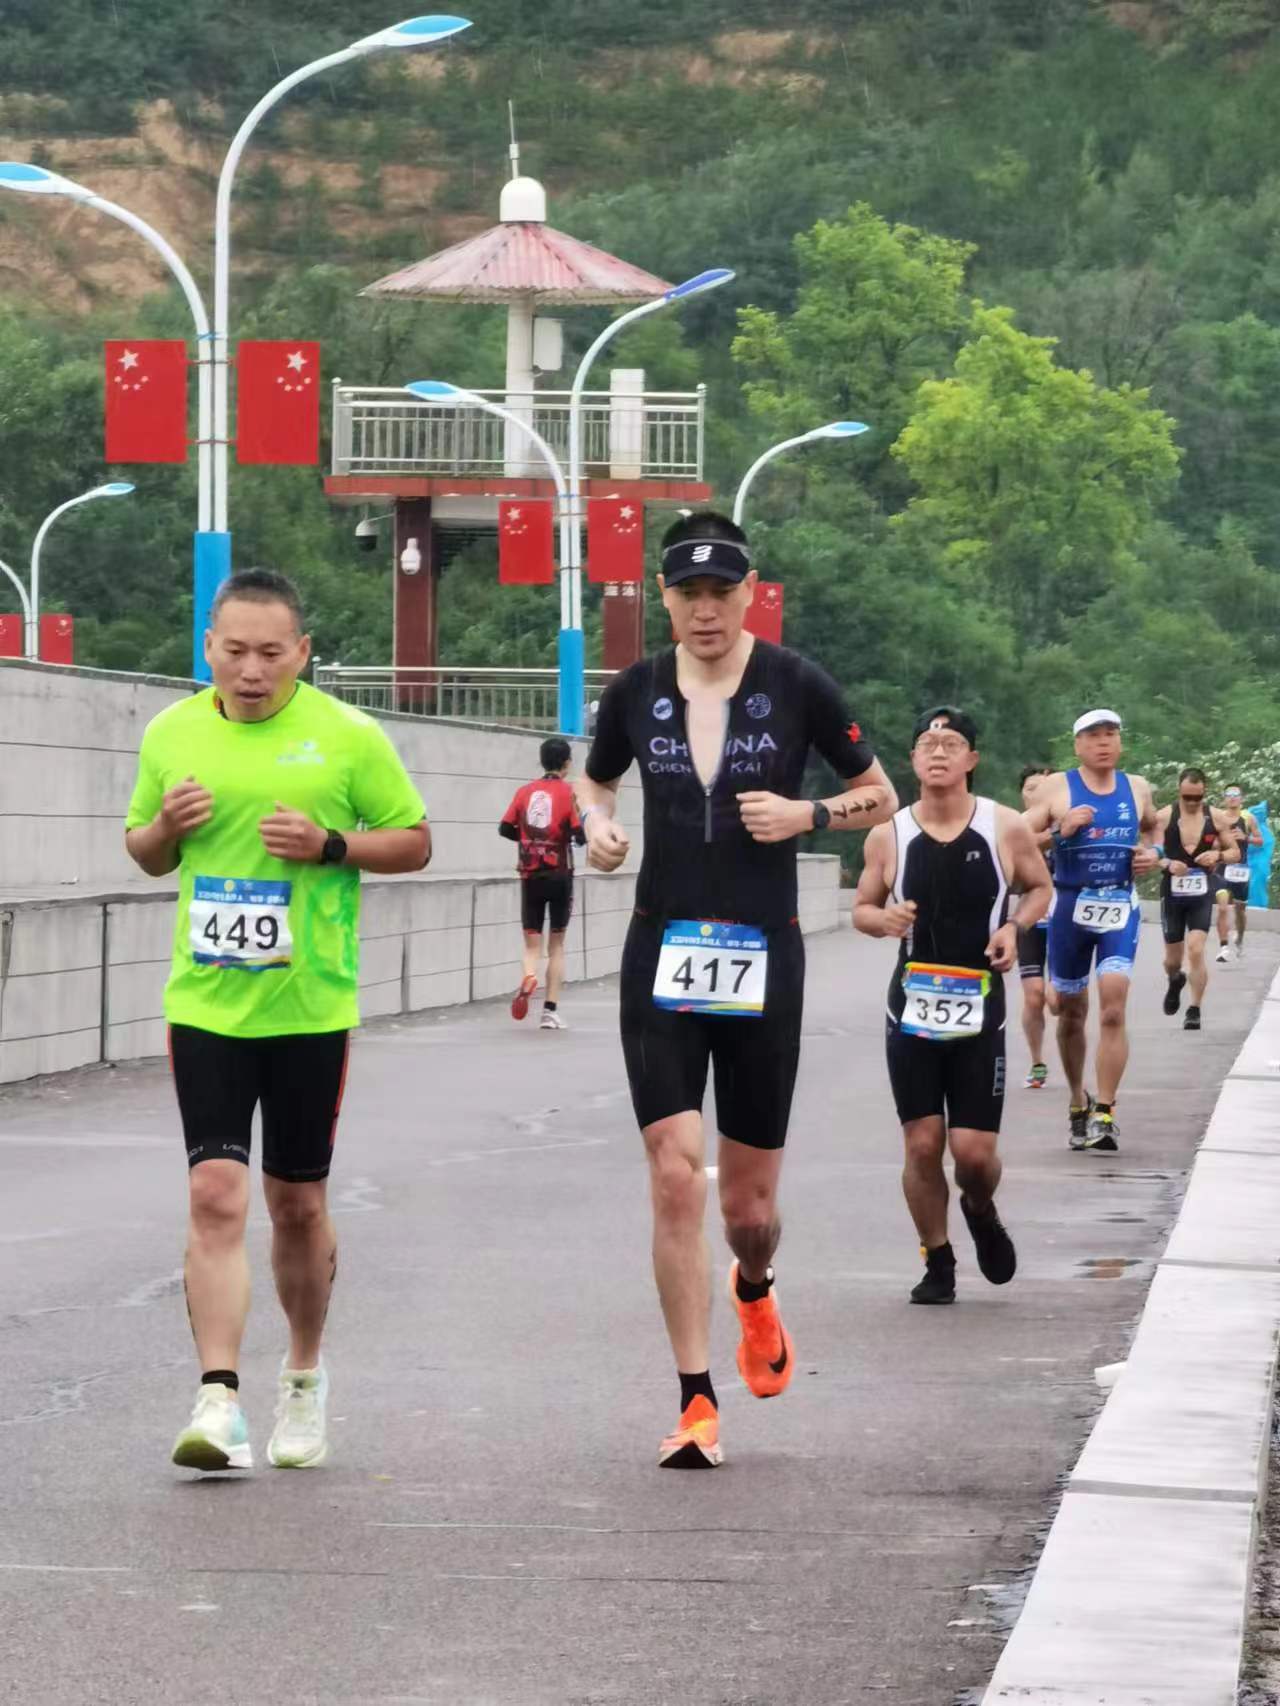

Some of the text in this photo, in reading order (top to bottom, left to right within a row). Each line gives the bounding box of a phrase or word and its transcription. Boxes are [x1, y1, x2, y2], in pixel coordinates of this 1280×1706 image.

[648, 761, 762, 775] CHEN KAI
[1177, 879, 1202, 890] 475
[1081, 905, 1122, 924] 573
[203, 912, 279, 950] 449
[671, 956, 753, 994] 417
[916, 997, 974, 1026] 352
